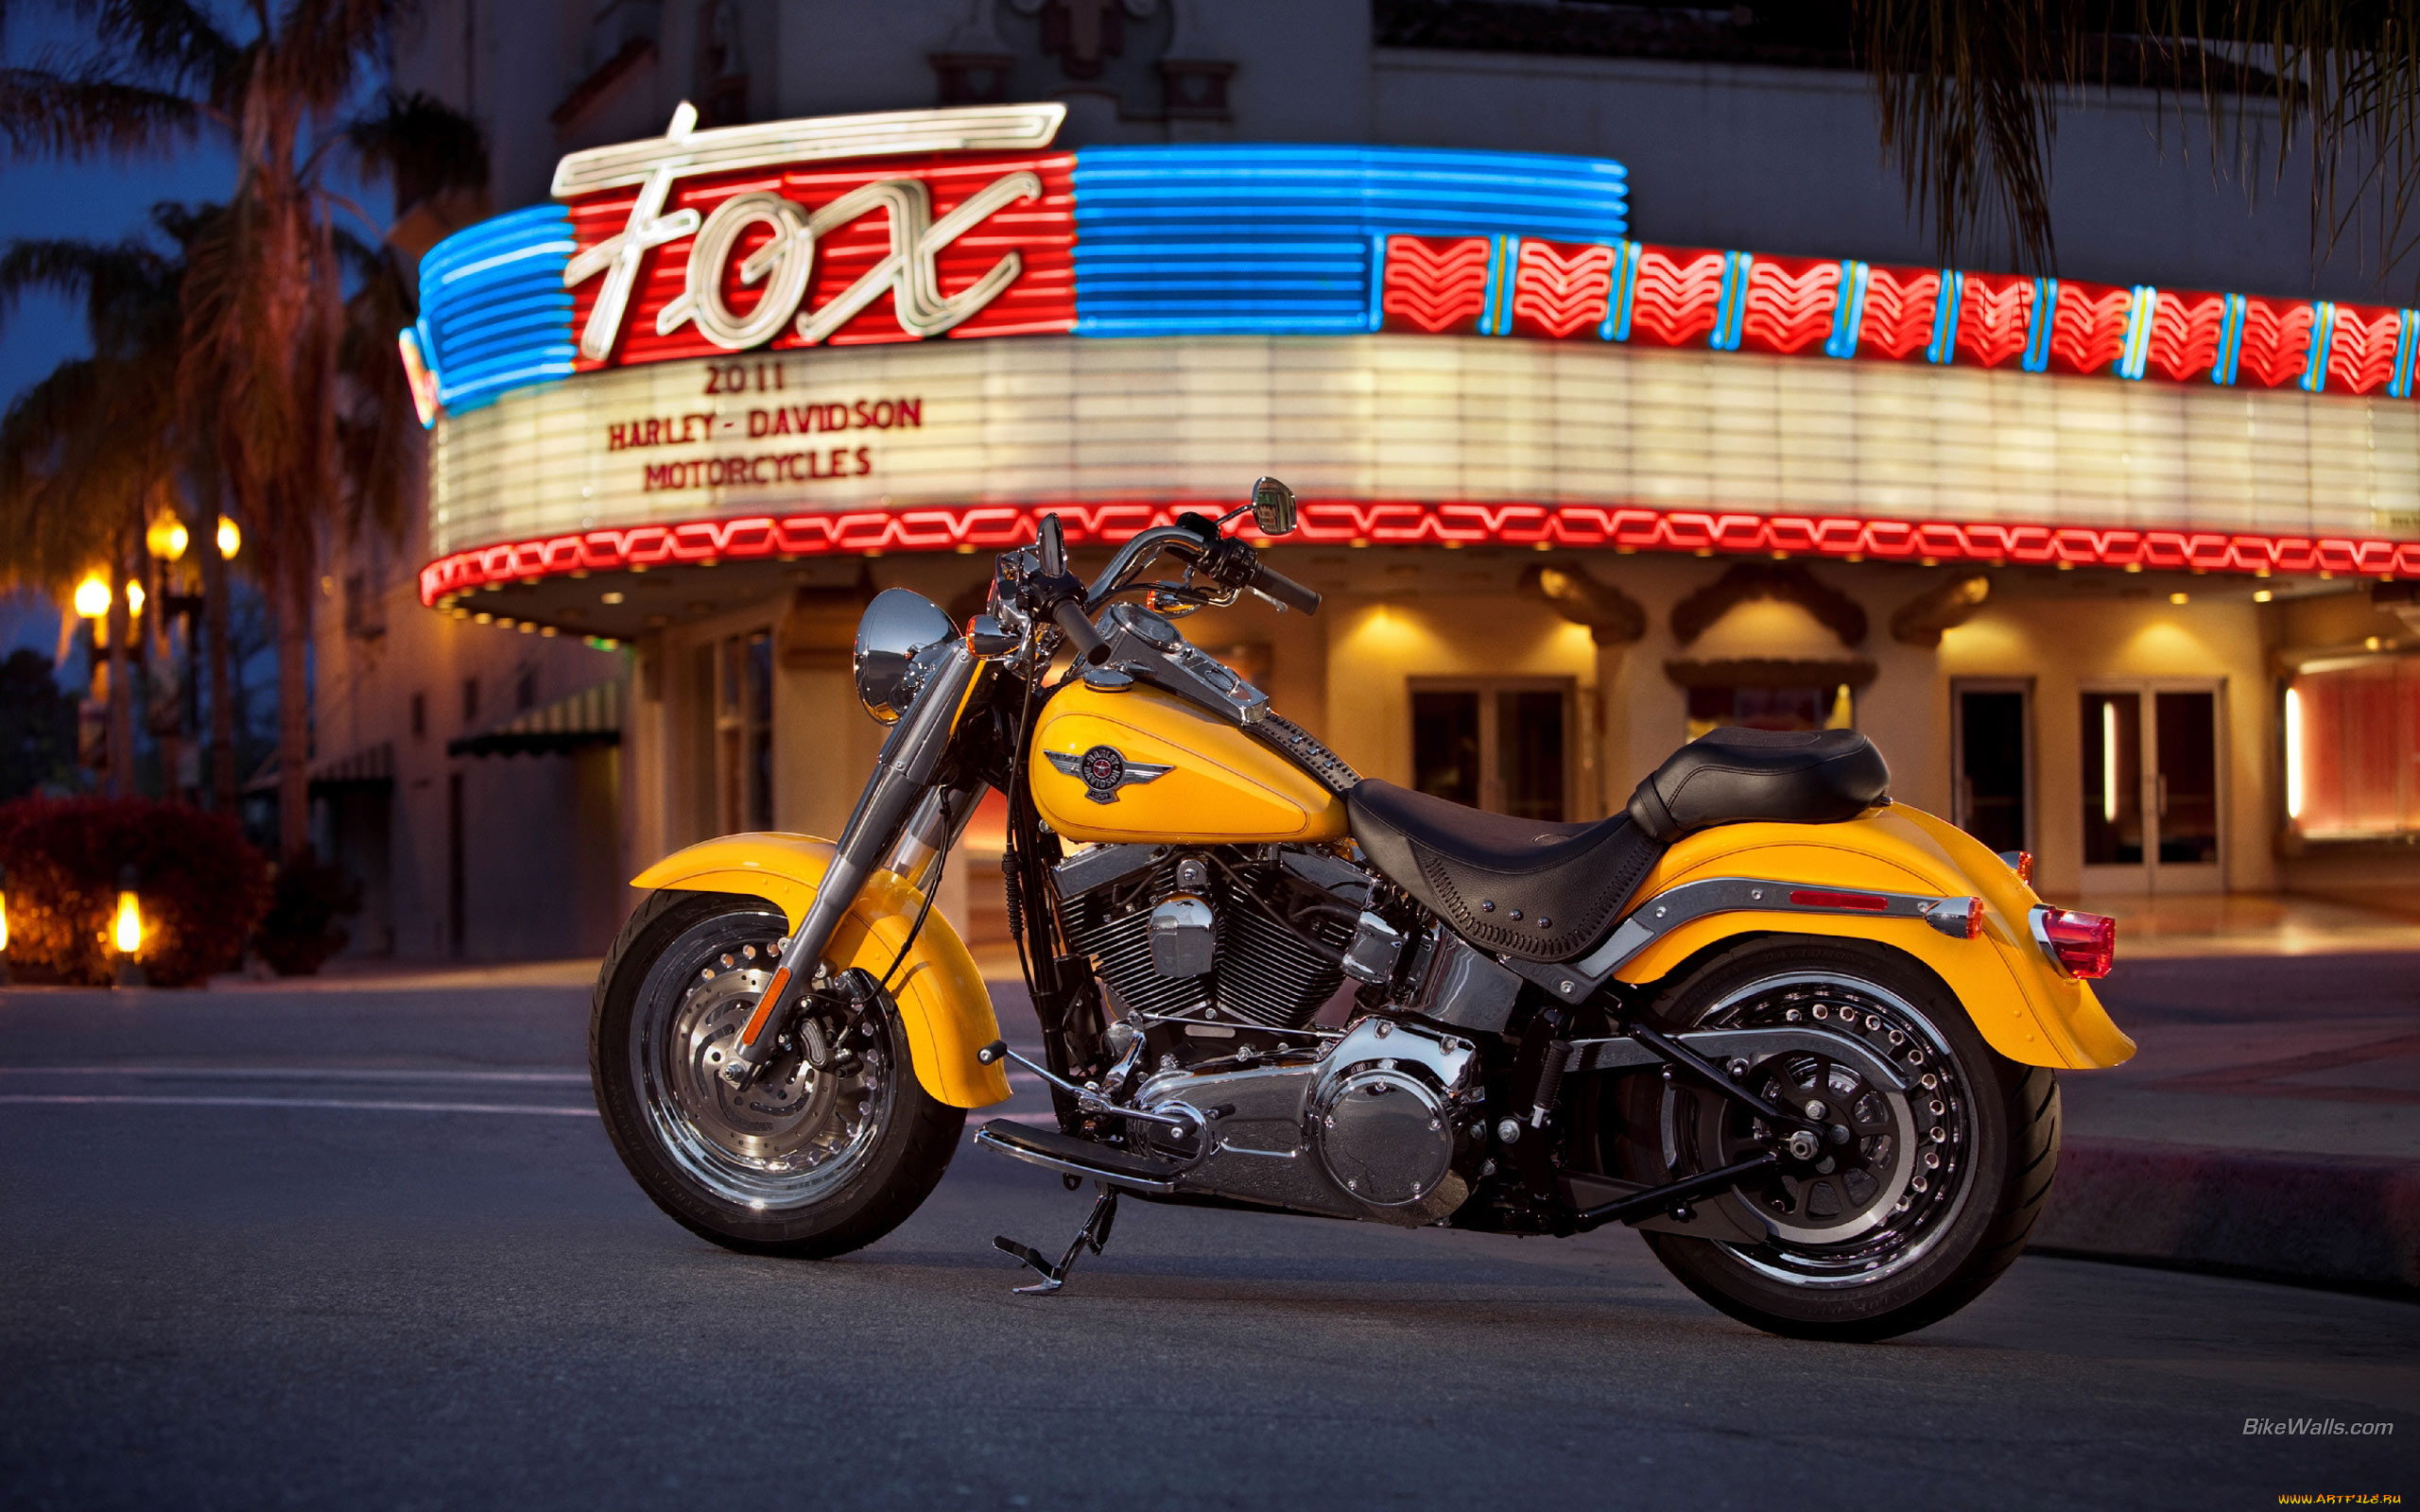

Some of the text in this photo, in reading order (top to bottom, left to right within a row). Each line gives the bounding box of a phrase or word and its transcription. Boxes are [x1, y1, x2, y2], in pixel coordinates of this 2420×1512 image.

[550, 100, 1066, 361] Fox
[704, 364, 786, 395] 2011
[609, 414, 717, 451] HARLEY
[748, 398, 923, 438] DAVIDSON
[644, 447, 872, 492] MOTORCYCLES
[1087, 749, 1120, 765] HARLEY
[1084, 766, 1120, 788] DAVIDSON
